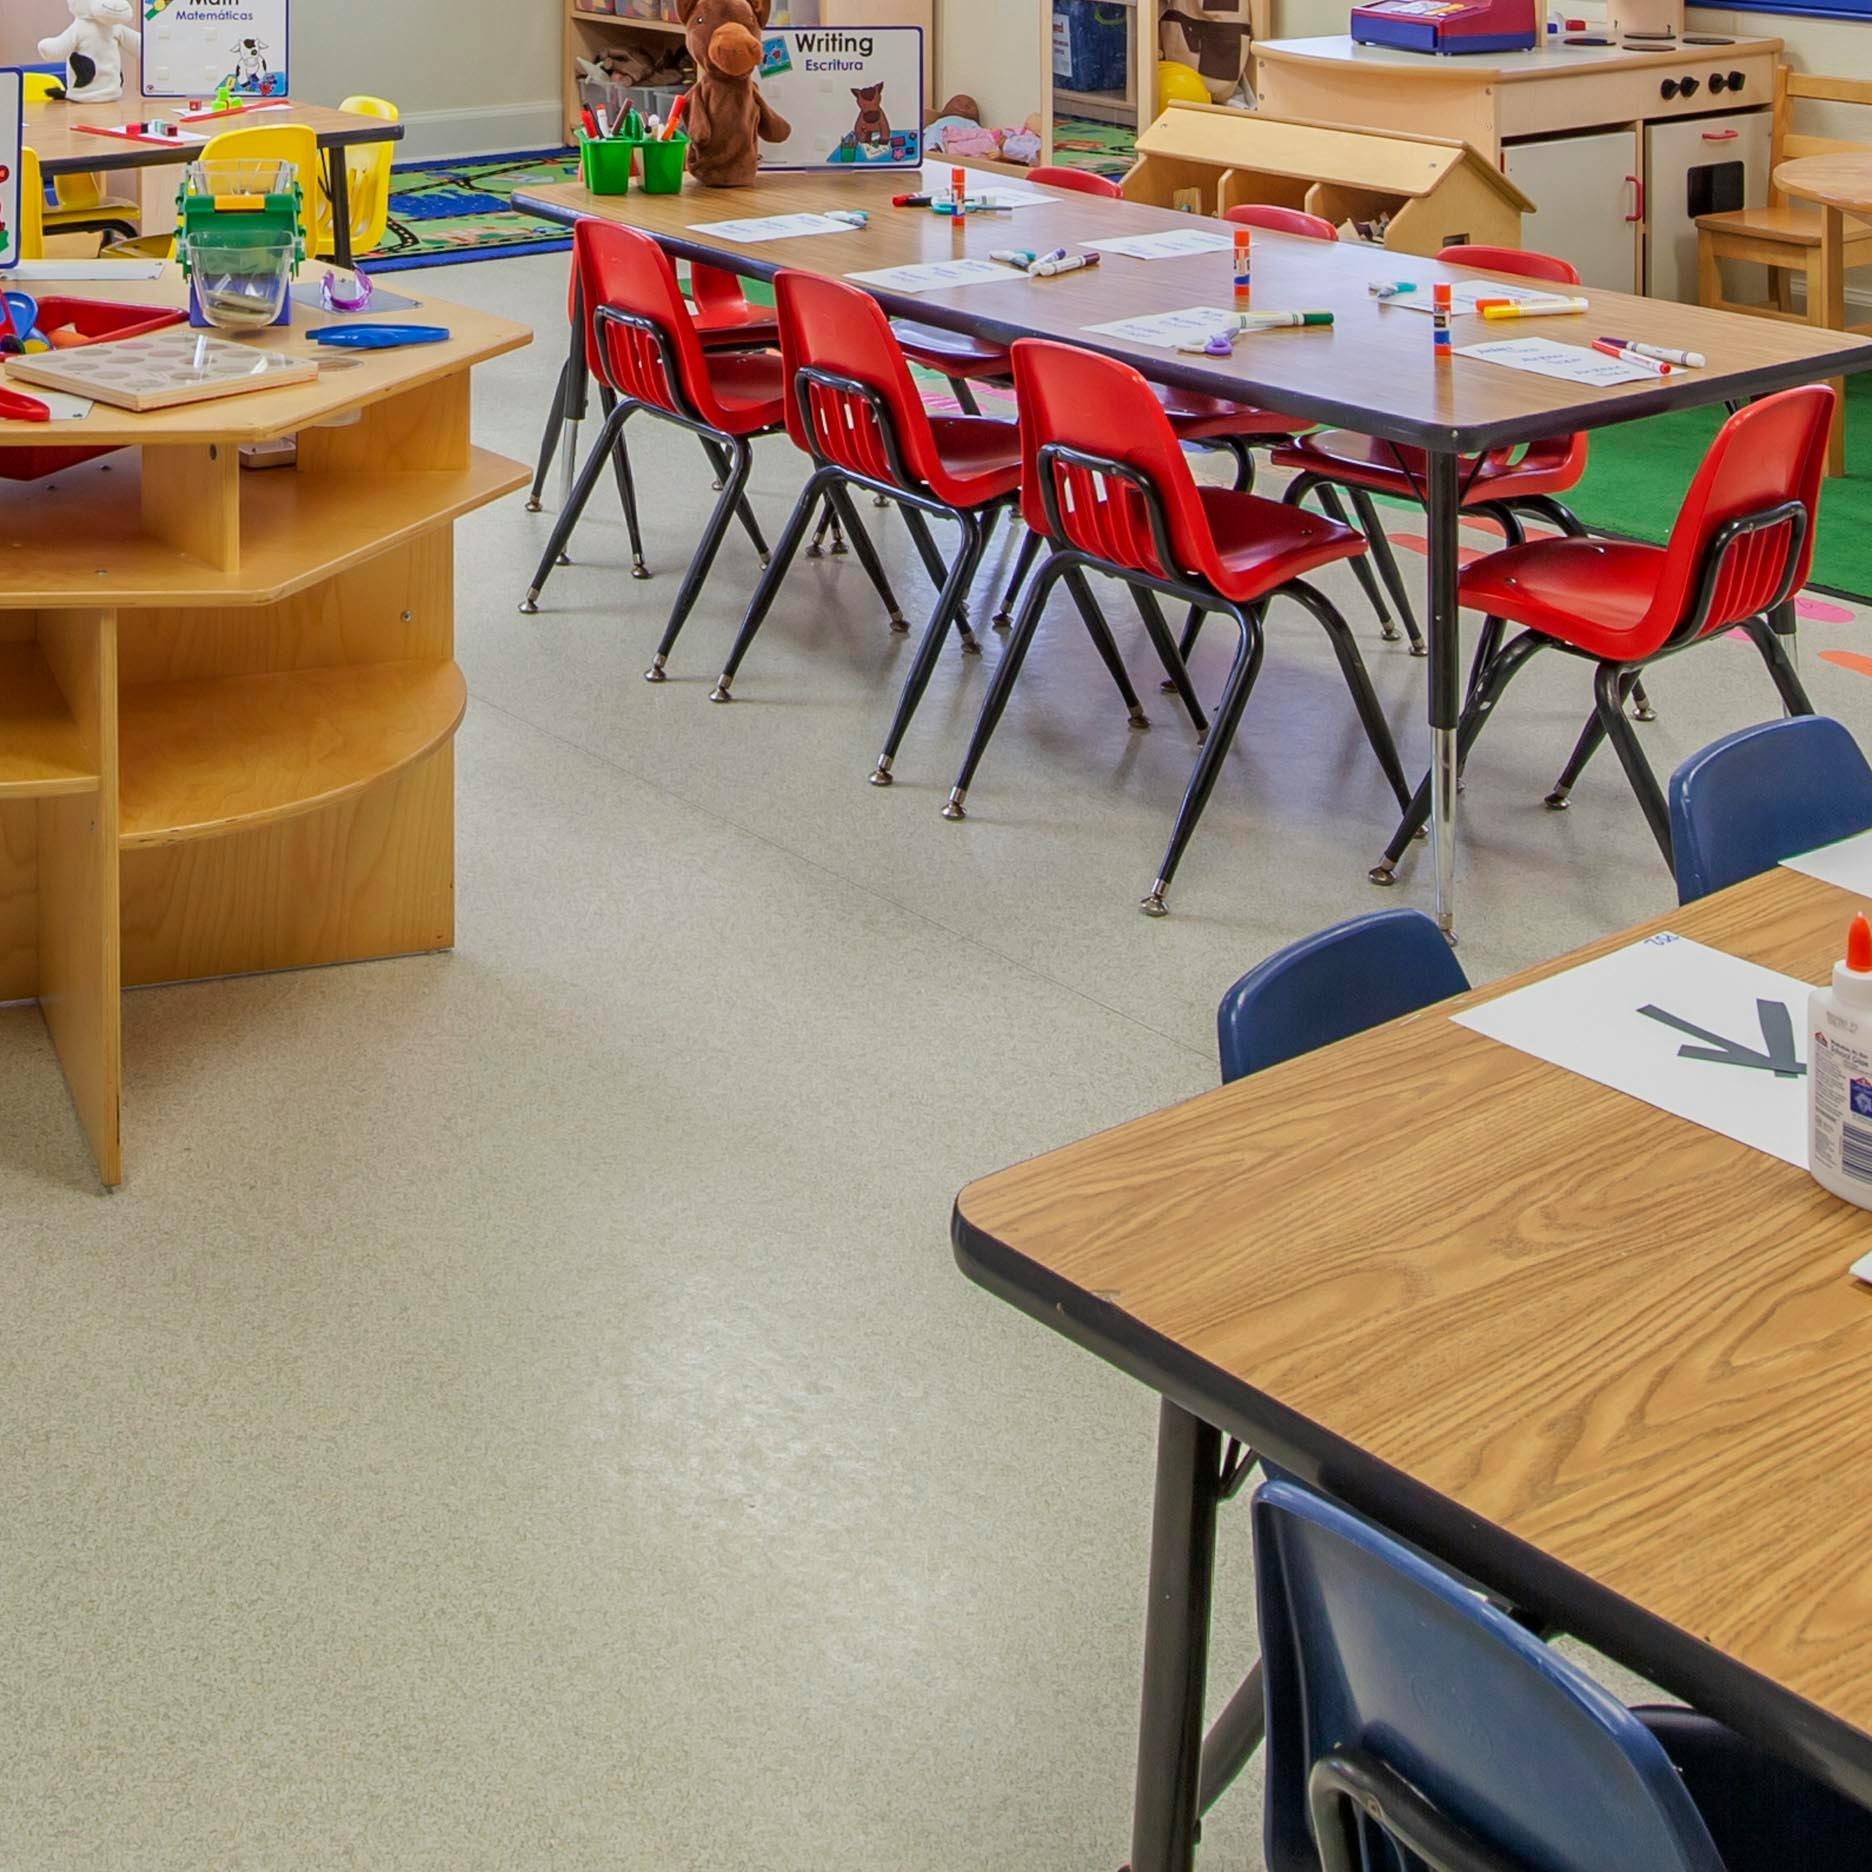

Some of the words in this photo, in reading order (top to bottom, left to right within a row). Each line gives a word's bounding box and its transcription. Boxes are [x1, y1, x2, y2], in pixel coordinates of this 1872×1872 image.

[176, 9, 254, 22] Matemáticas
[796, 33, 873, 56] Writing
[806, 58, 864, 72] Escritura
